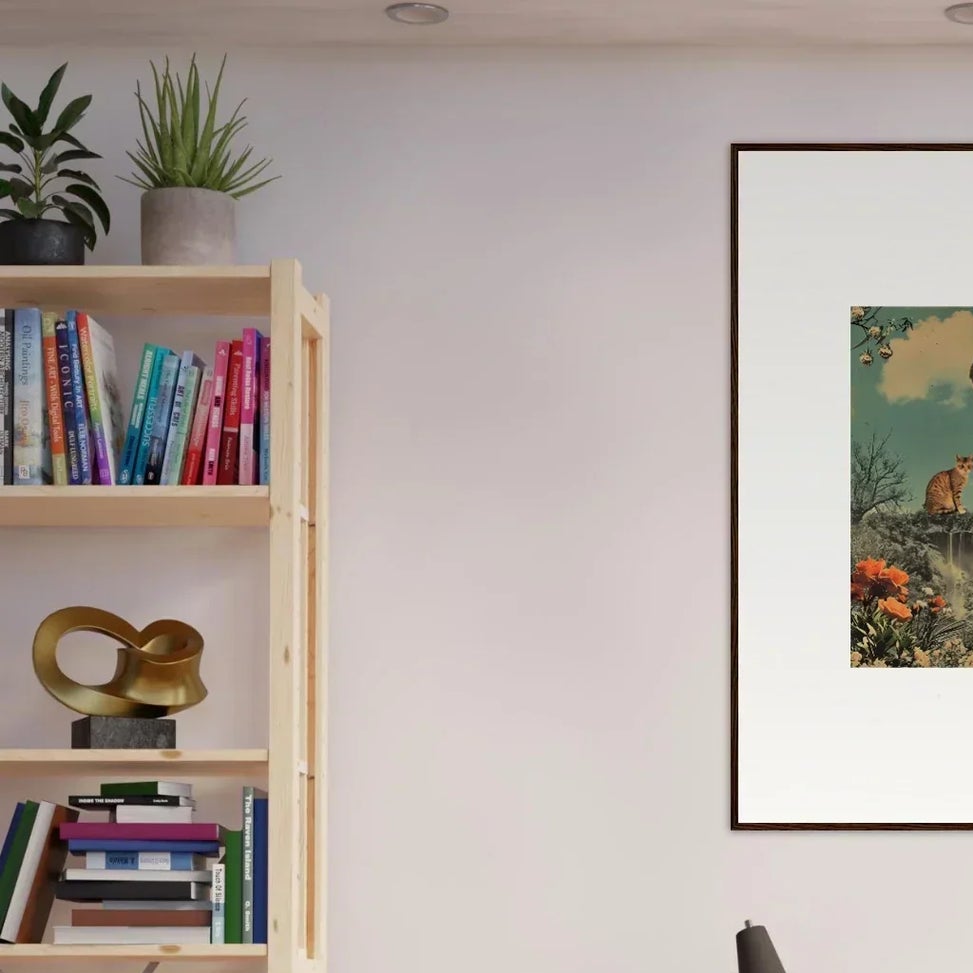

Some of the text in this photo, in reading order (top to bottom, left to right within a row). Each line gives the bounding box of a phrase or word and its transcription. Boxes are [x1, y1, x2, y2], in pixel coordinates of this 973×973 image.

[18, 325, 32, 386] Oil Paintings
[47, 347, 56, 363] FINE
[72, 344, 80, 358] Find
[58, 344, 74, 408] ICONIC
[72, 360, 81, 384] Beauty
[79, 326, 98, 412] Watercolor Portraits
[50, 385, 59, 402] With
[176, 385, 184, 397] ART
[230, 363, 240, 416] Parenting Skills
[50, 403, 61, 425] Digital
[52, 426, 62, 443] Tools
[80, 440, 88, 472] NORMAN
[244, 816, 252, 847] Raven
[244, 850, 252, 880] Island
